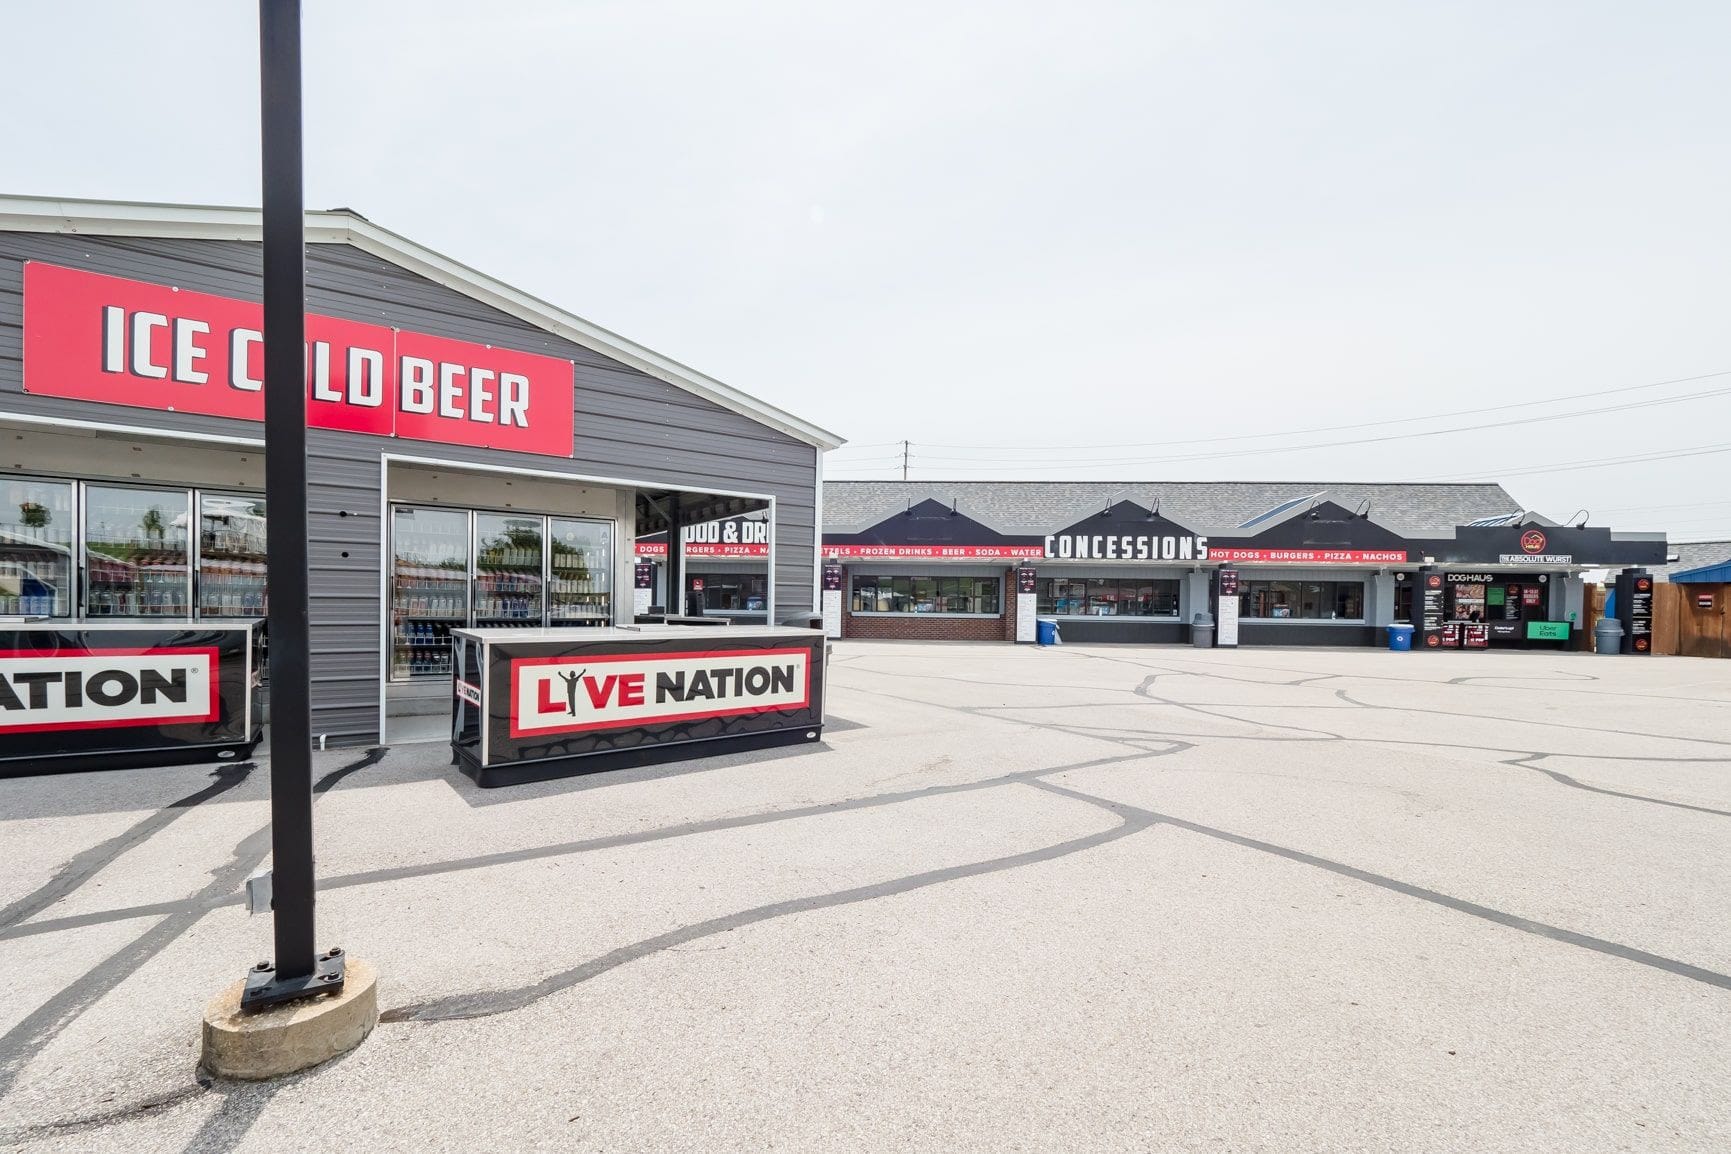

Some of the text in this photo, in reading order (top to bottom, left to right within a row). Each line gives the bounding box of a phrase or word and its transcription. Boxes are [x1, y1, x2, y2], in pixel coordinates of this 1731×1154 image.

[102, 304, 531, 428] ICE CLD BEER
[723, 521, 738, 543] &
[724, 546, 750, 554] PIZZA
[860, 547, 896, 555] FROZEN
[898, 547, 932, 555] DRINKS
[975, 548, 1001, 556] SODA
[1044, 535, 1208, 560] CONCESSIONS
[1233, 551, 1260, 559] DOGS
[1270, 551, 1315, 559] BURGERS
[1324, 552, 1352, 560] PIZZA
[537, 664, 795, 717] LIVE NATION
